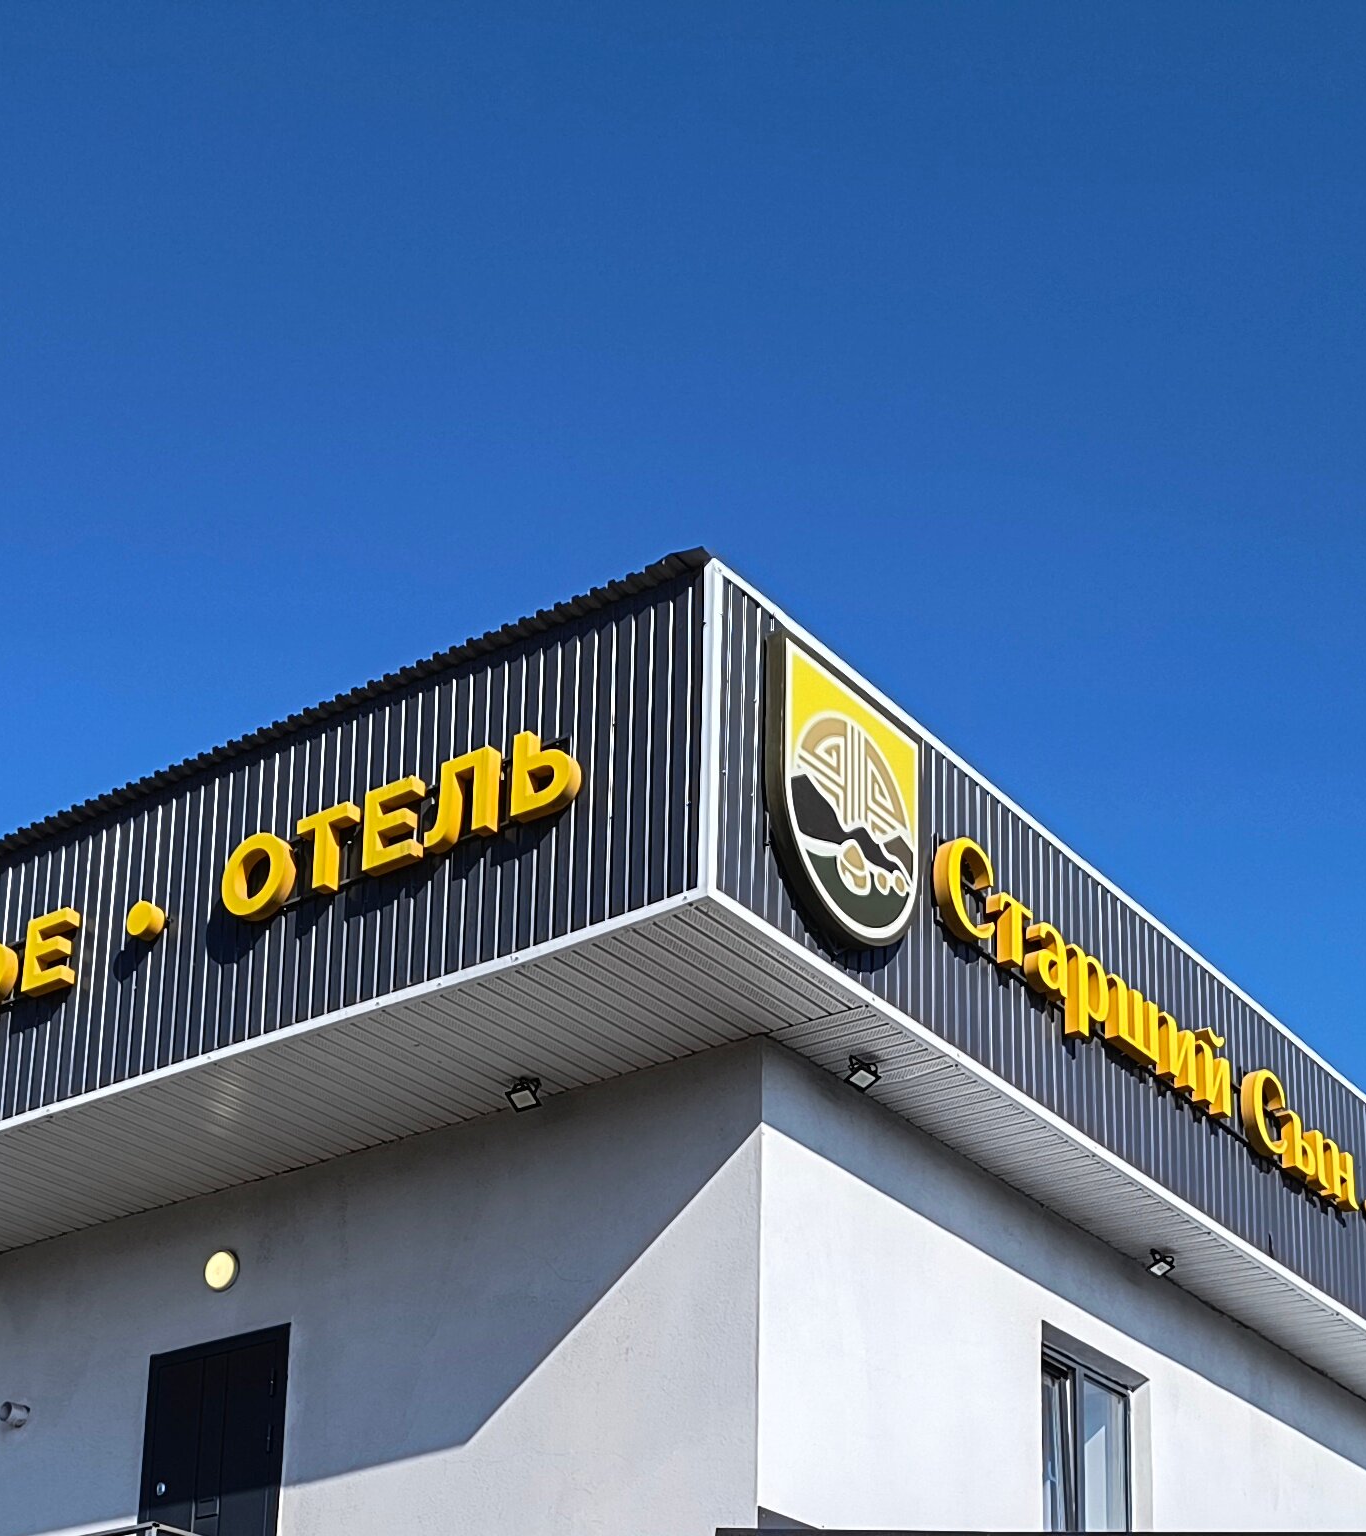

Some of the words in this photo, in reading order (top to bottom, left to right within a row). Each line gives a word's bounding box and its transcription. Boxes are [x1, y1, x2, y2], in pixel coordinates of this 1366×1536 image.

[221, 730, 582, 921] ОТЕЛЬ
[934, 837, 1232, 1119] Старший
[1240, 1068, 1360, 1211] Сын
